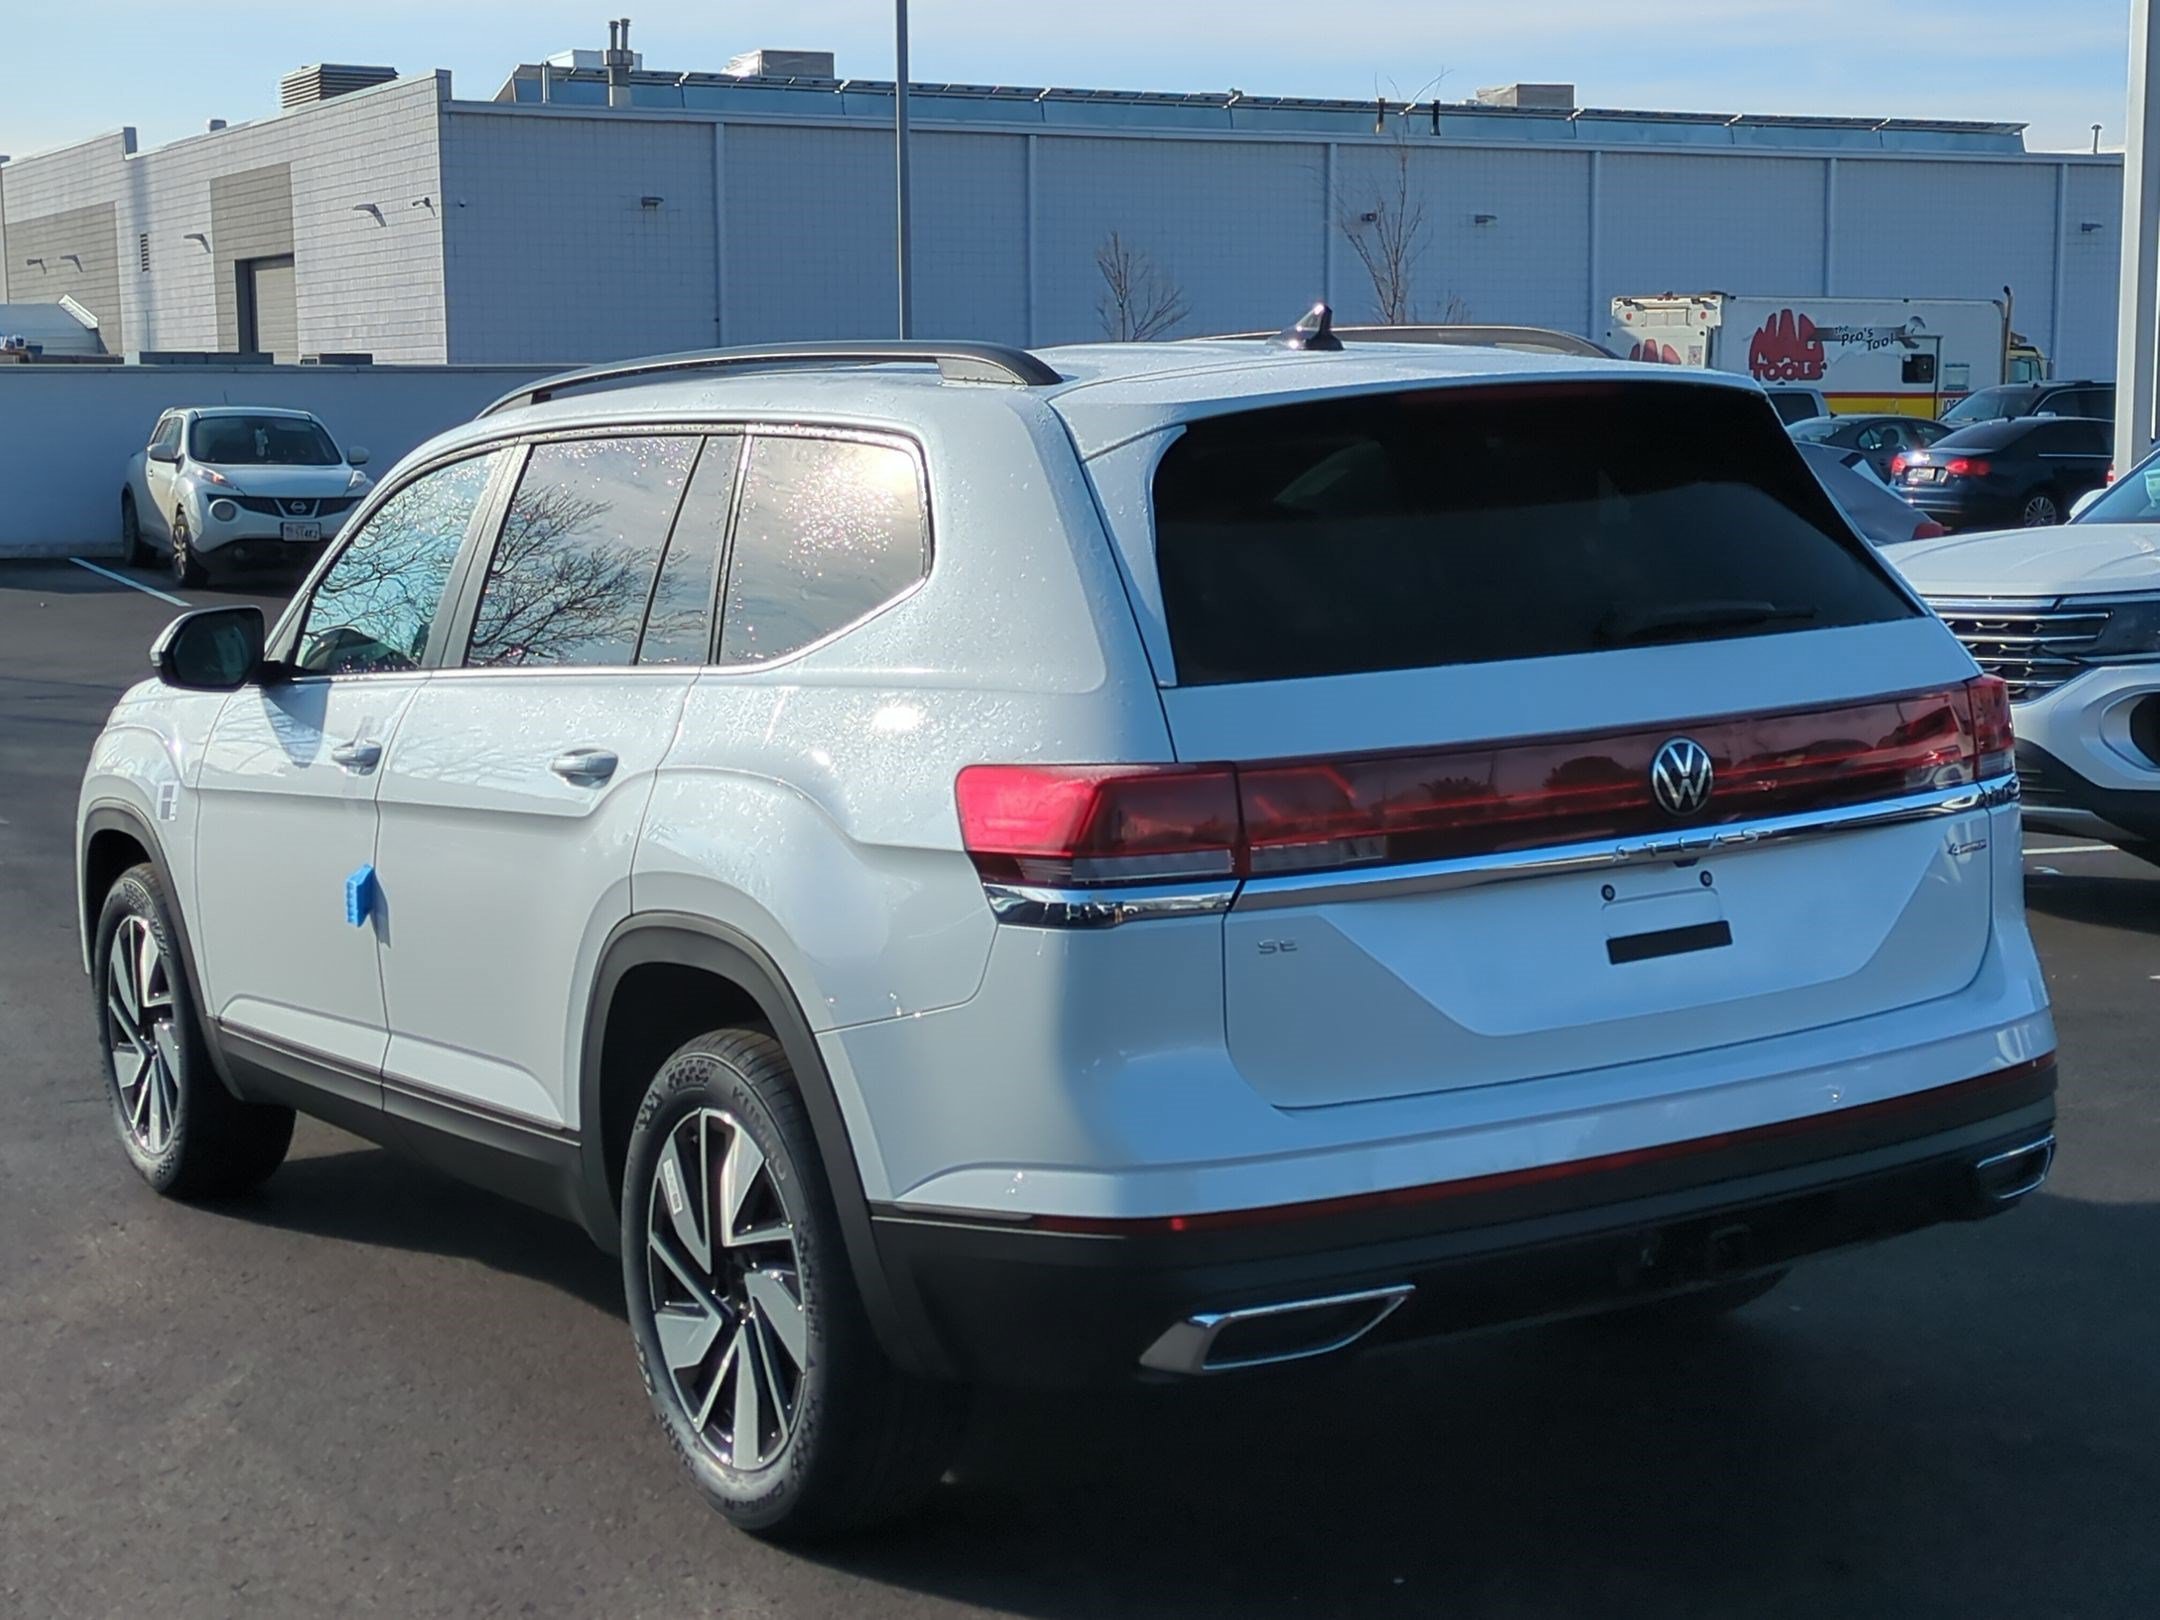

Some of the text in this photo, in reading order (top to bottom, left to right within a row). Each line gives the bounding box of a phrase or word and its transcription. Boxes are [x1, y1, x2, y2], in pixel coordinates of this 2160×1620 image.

[1653, 737, 1713, 816] VW
[1612, 828, 1773, 862] ATLAS
[1257, 939, 1298, 955] SE
